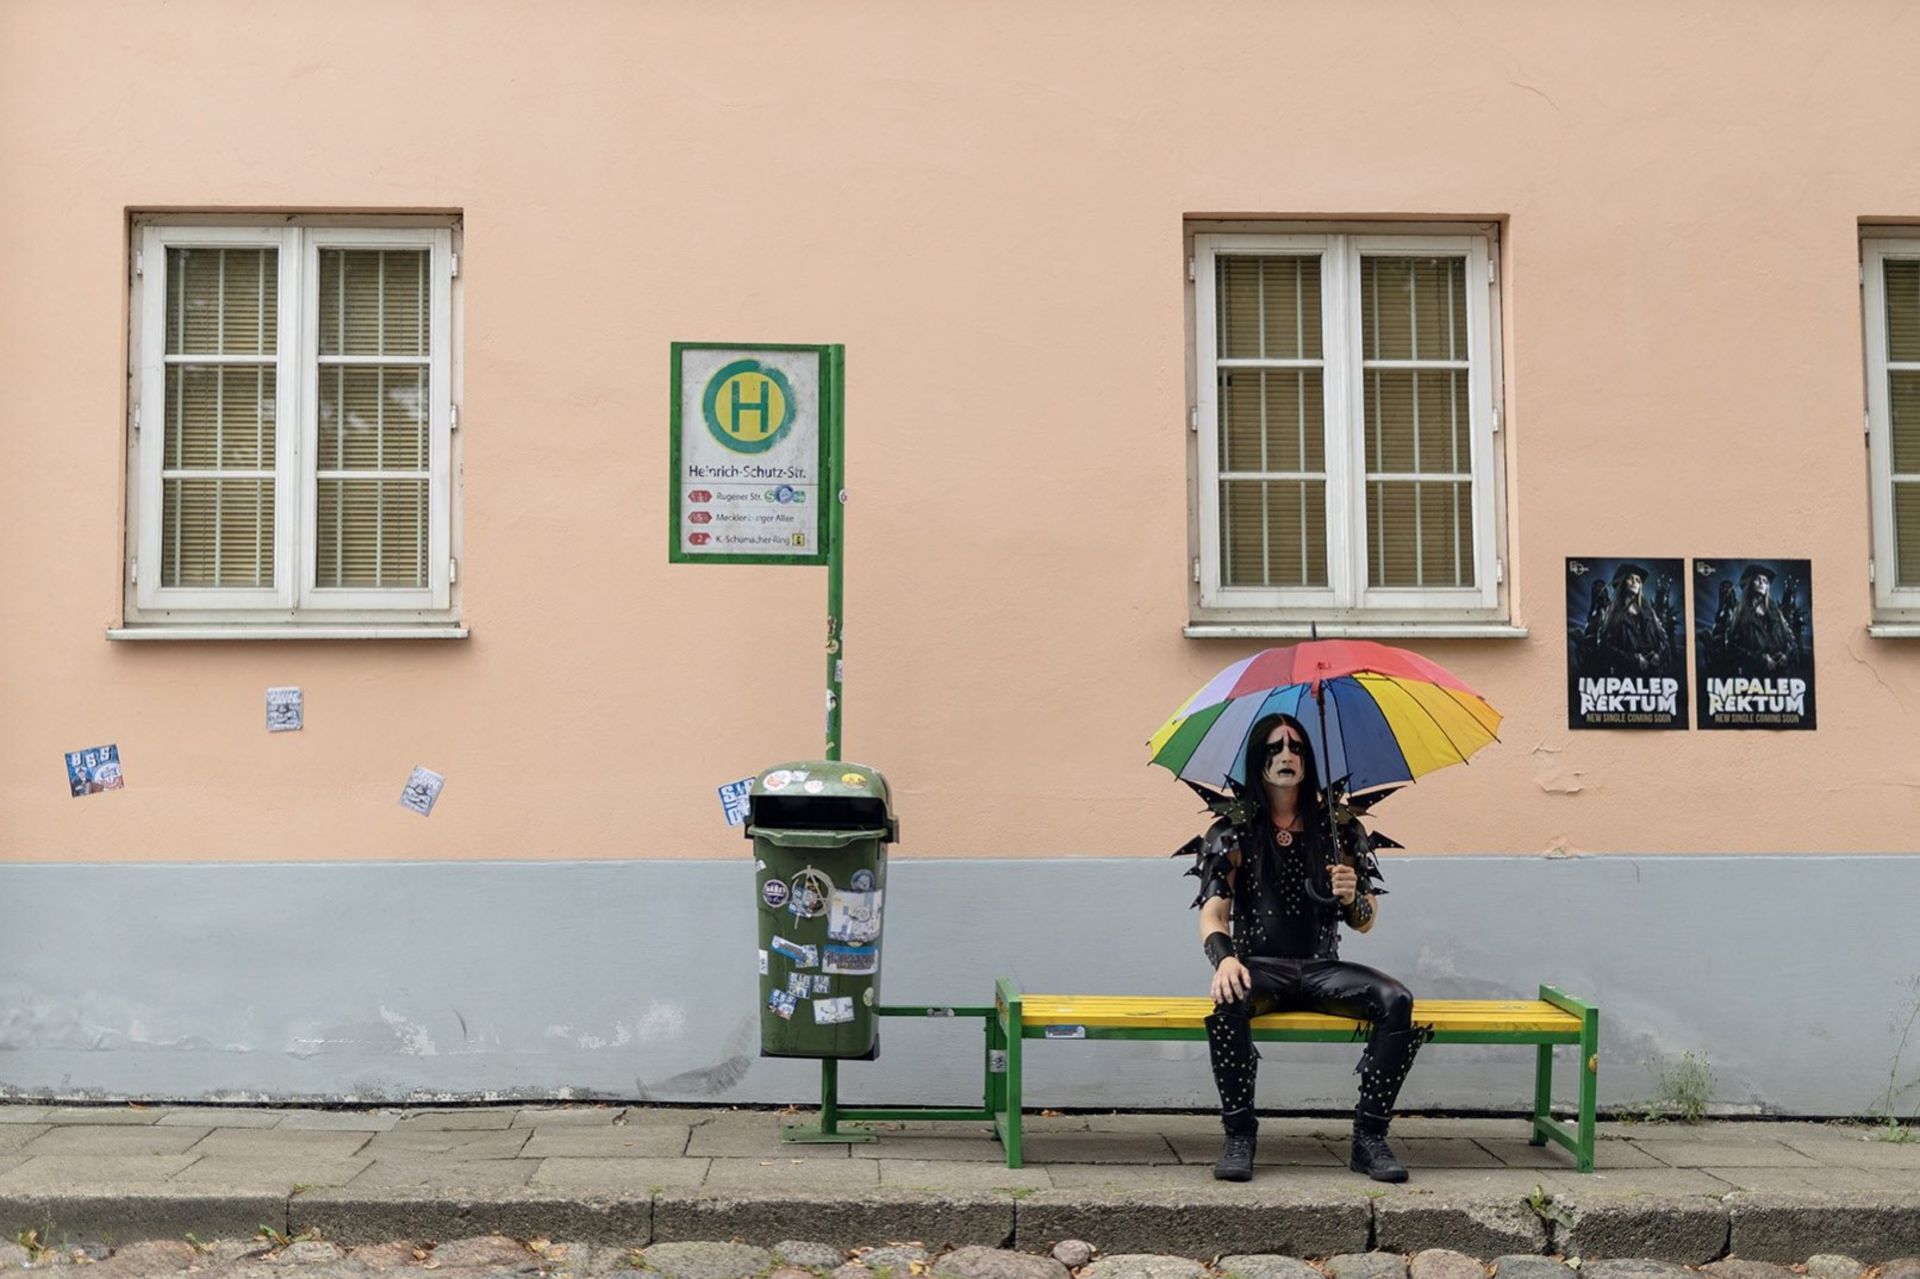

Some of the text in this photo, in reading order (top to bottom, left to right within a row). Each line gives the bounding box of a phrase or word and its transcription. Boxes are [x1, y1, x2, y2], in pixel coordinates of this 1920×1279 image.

[731, 380, 769, 433] H
[775, 513, 795, 523] Allee
[1579, 677, 1679, 701] IMPALED
[1706, 677, 1806, 701] IMPALED
[1580, 692, 1677, 716] REKTUM
[1708, 692, 1805, 716] REKTUM
[1585, 713, 1602, 723] NEW
[1654, 713, 1672, 723] SOON
[1714, 713, 1730, 723] NEW
[1782, 713, 1799, 723] SOON
